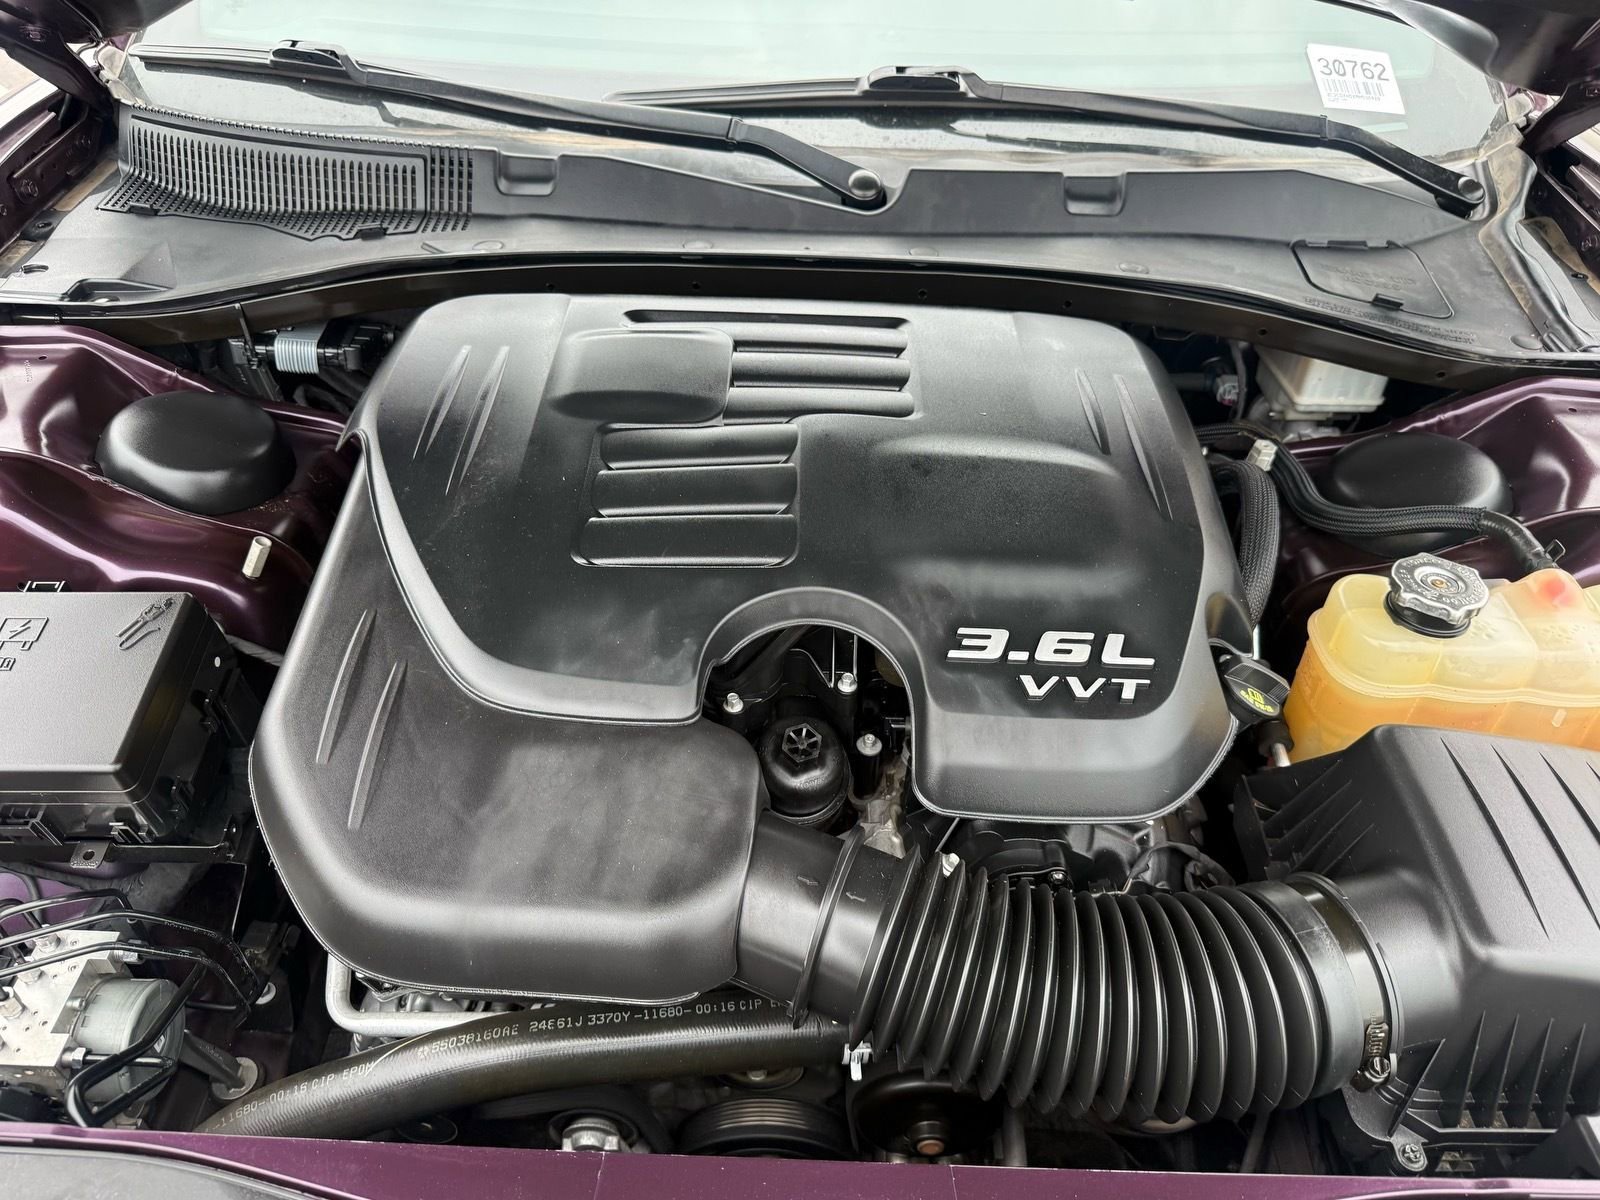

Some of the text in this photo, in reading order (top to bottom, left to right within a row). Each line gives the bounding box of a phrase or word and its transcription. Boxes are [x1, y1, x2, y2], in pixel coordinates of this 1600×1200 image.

[1317, 57, 1390, 81] 30762
[946, 627, 1156, 669] 3.6L
[1018, 674, 1151, 703] VVT
[431, 1023, 519, 1053] 55038160AE
